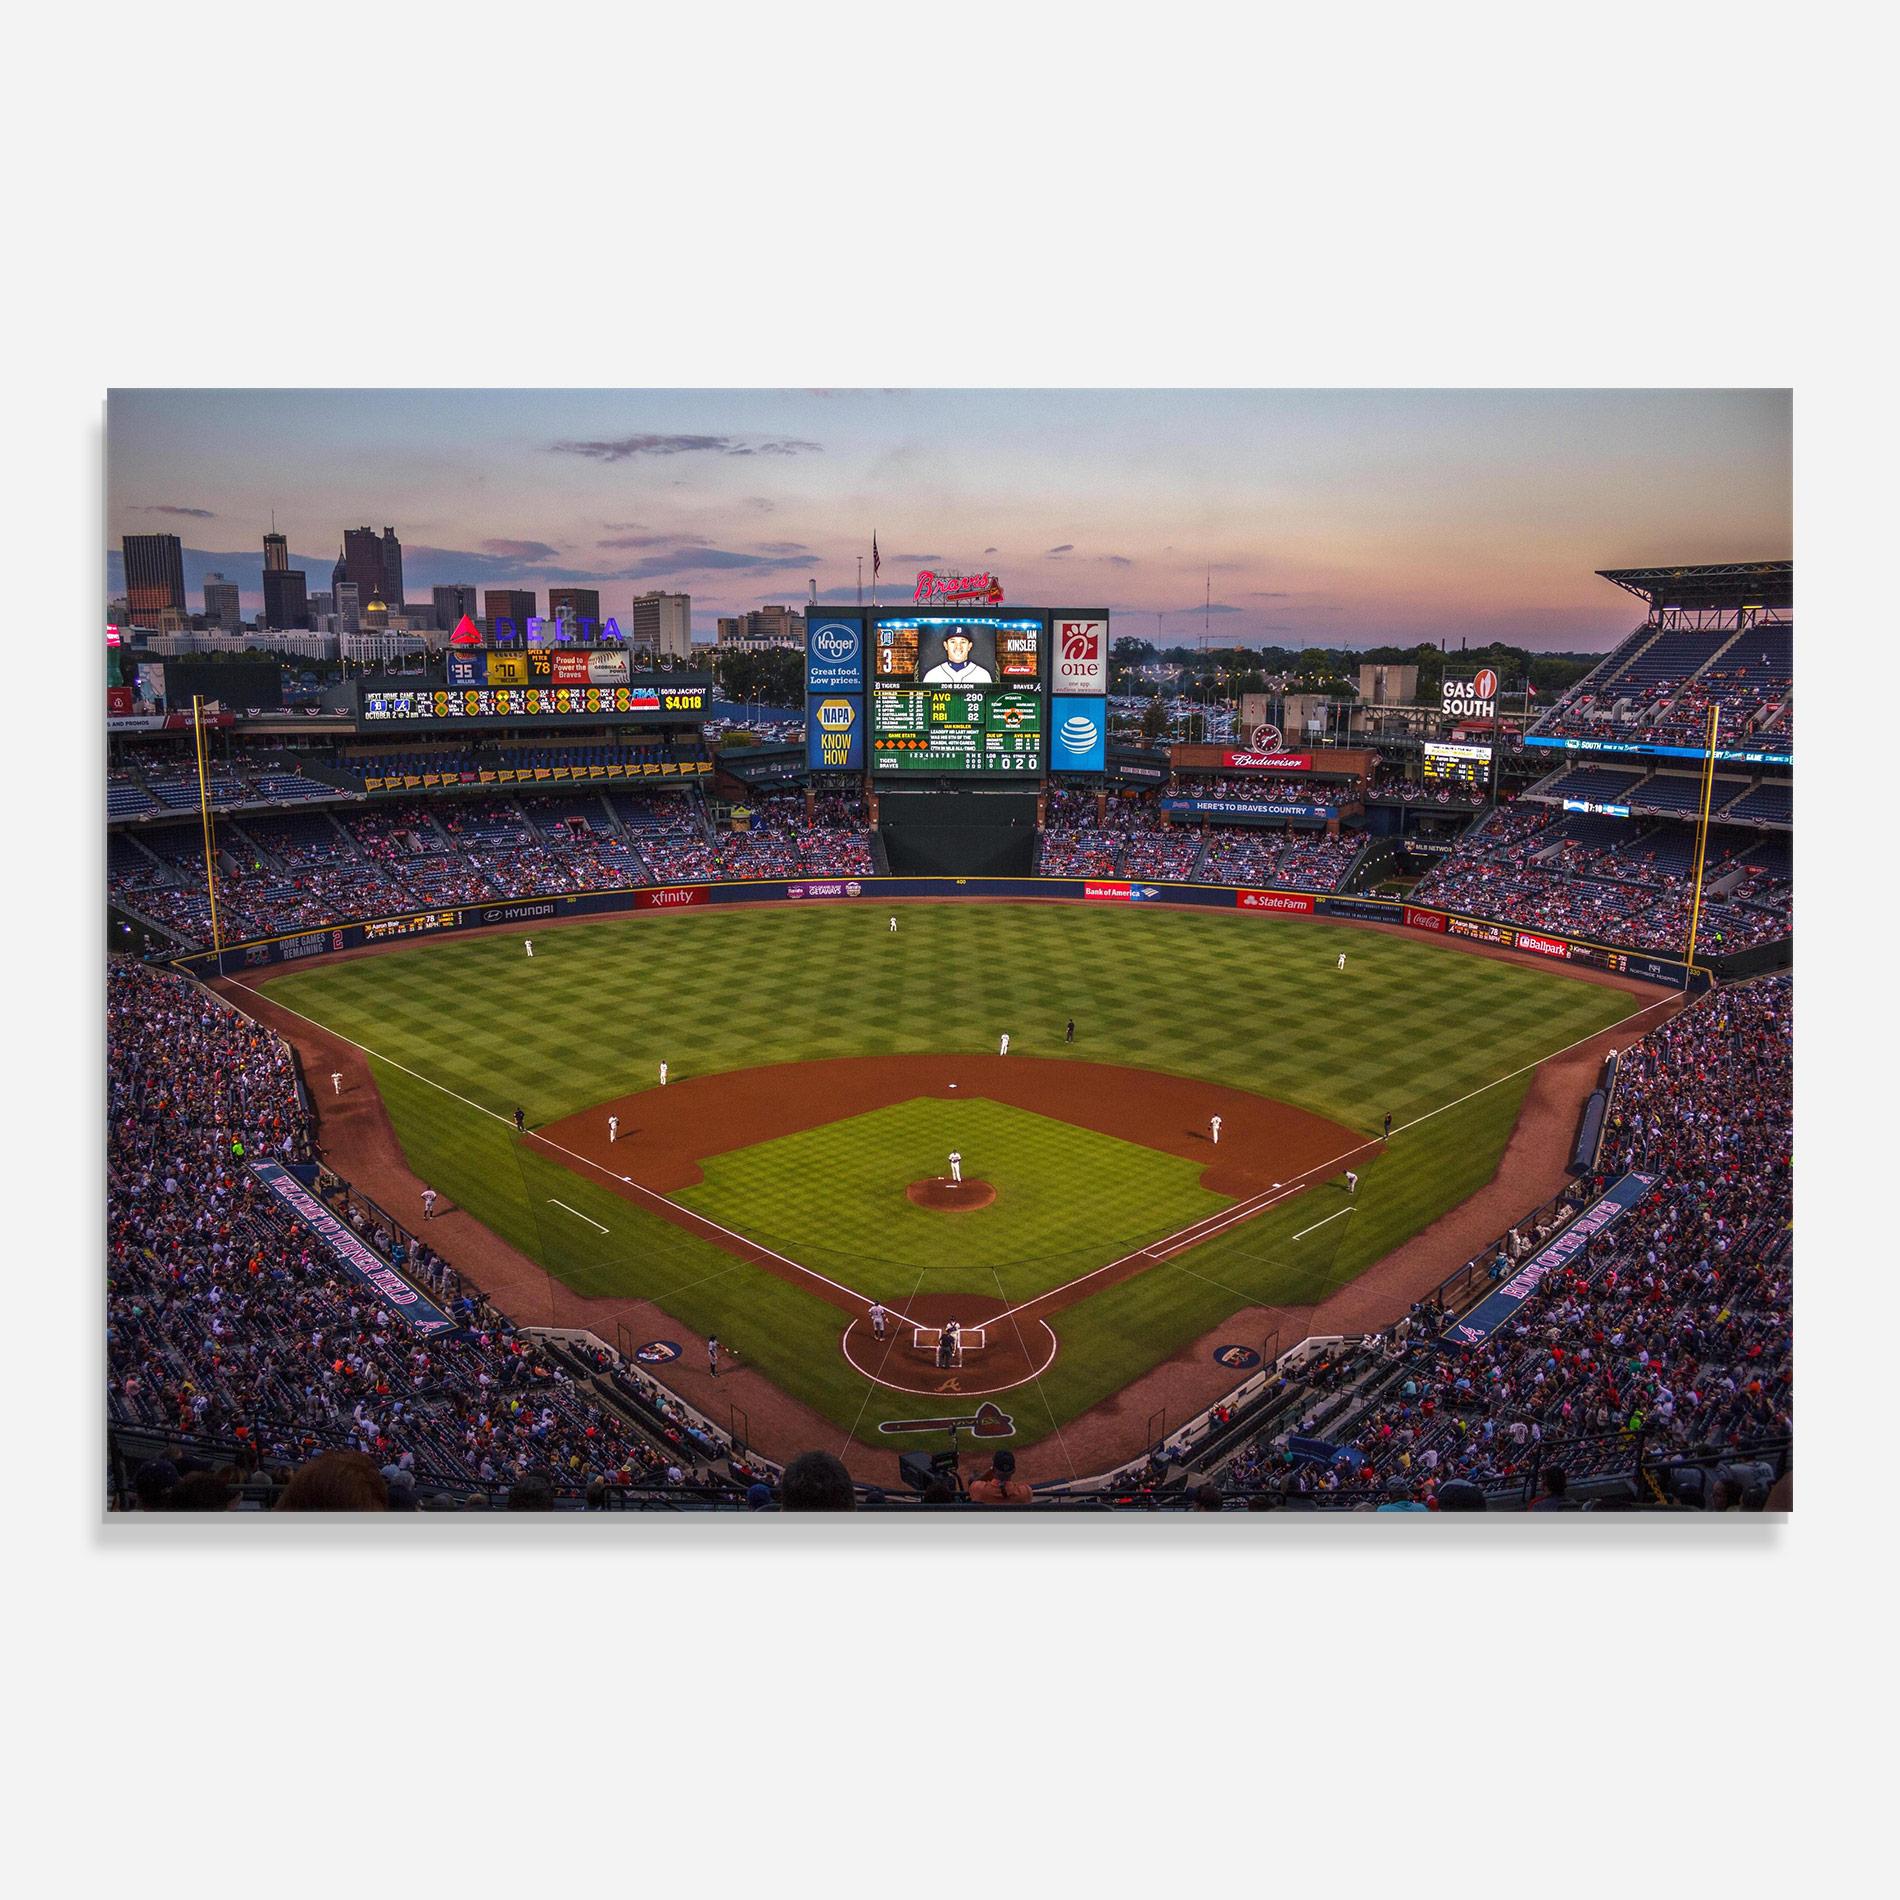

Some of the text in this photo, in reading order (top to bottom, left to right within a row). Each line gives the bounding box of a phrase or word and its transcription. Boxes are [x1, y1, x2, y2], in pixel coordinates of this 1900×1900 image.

[914, 570, 991, 603] Braves
[496, 617, 624, 641] DELTA
[1026, 629, 1037, 639] IAN
[818, 631, 853, 657] Kroger
[1007, 639, 1037, 652] KINSLER
[883, 648, 892, 673] 3
[451, 664, 473, 678] $35
[495, 664, 515, 677] $70
[534, 662, 551, 675] 78
[559, 671, 582, 679] Braves
[1061, 663, 1098, 676] one
[831, 677, 861, 686] prices.
[383, 692, 399, 700] HOME
[400, 692, 415, 700] GAME
[1443, 682, 1475, 699] GAS
[665, 696, 702, 710] $4,018
[933, 694, 951, 702] AVG
[964, 694, 983, 702] .290
[1442, 699, 1495, 718] SOUTH
[365, 711, 391, 720] OCTOBER
[392, 711, 397, 719] 2
[824, 708, 850, 723] NAPA
[933, 713, 979, 721] RBI 82
[821, 734, 852, 749] KNOW
[1581, 741, 1602, 750] SOUTH
[824, 750, 848, 765] HOW
[1002, 758, 1037, 769] 0 2 0
[1232, 754, 1302, 767] Budweiser
[1268, 806, 1307, 815] COUNTRY
[651, 890, 693, 906] xfinity
[808, 888, 842, 896] GETAWAYS
[1085, 887, 1141, 897] Bank of America
[505, 905, 554, 919] HYUNDAI
[1490, 928, 1499, 936] 78
[279, 933, 326, 951] HOME GAMES
[332, 929, 344, 950] 2
[284, 943, 324, 960] REMAINING
[1529, 939, 1566, 956] Ballpark
[1573, 946, 1591, 956] Kinsler
[1689, 968, 1701, 977] 330
[270, 1174, 419, 1305] WELCOME TO TURNER FIELD
[1500, 1200, 1622, 1299] HOME OF THE BRAVES
